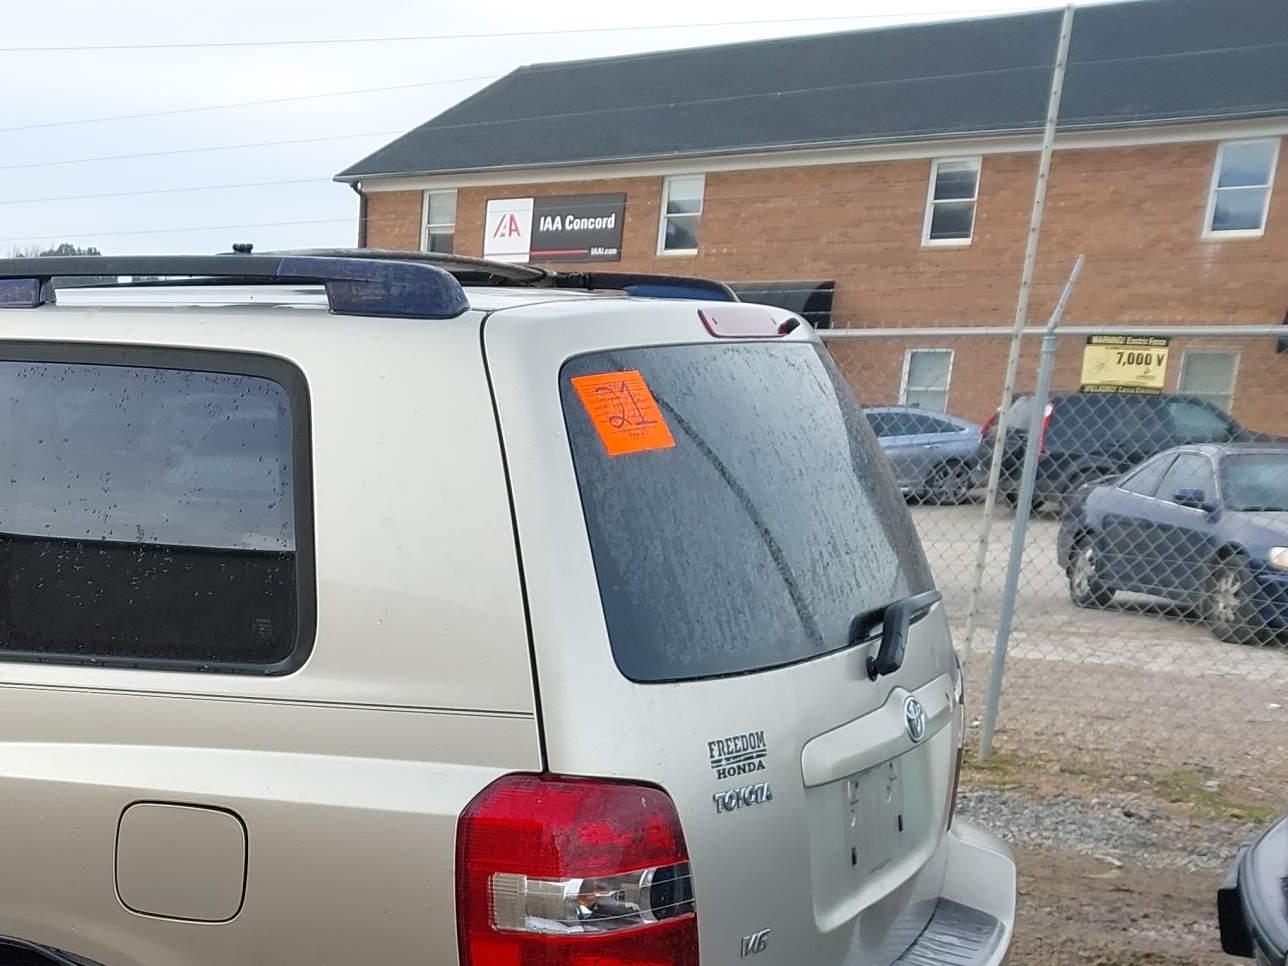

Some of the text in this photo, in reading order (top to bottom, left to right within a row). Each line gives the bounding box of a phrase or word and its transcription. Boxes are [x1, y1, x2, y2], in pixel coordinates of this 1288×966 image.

[539, 213, 616, 232] IAA Concord
[1116, 351, 1166, 368] 7,000 V
[595, 381, 658, 429] 21
[707, 730, 767, 760] FREEDOM
[716, 760, 767, 780] HONDA
[712, 783, 774, 814] TOYOTA
[741, 928, 771, 959] V6
